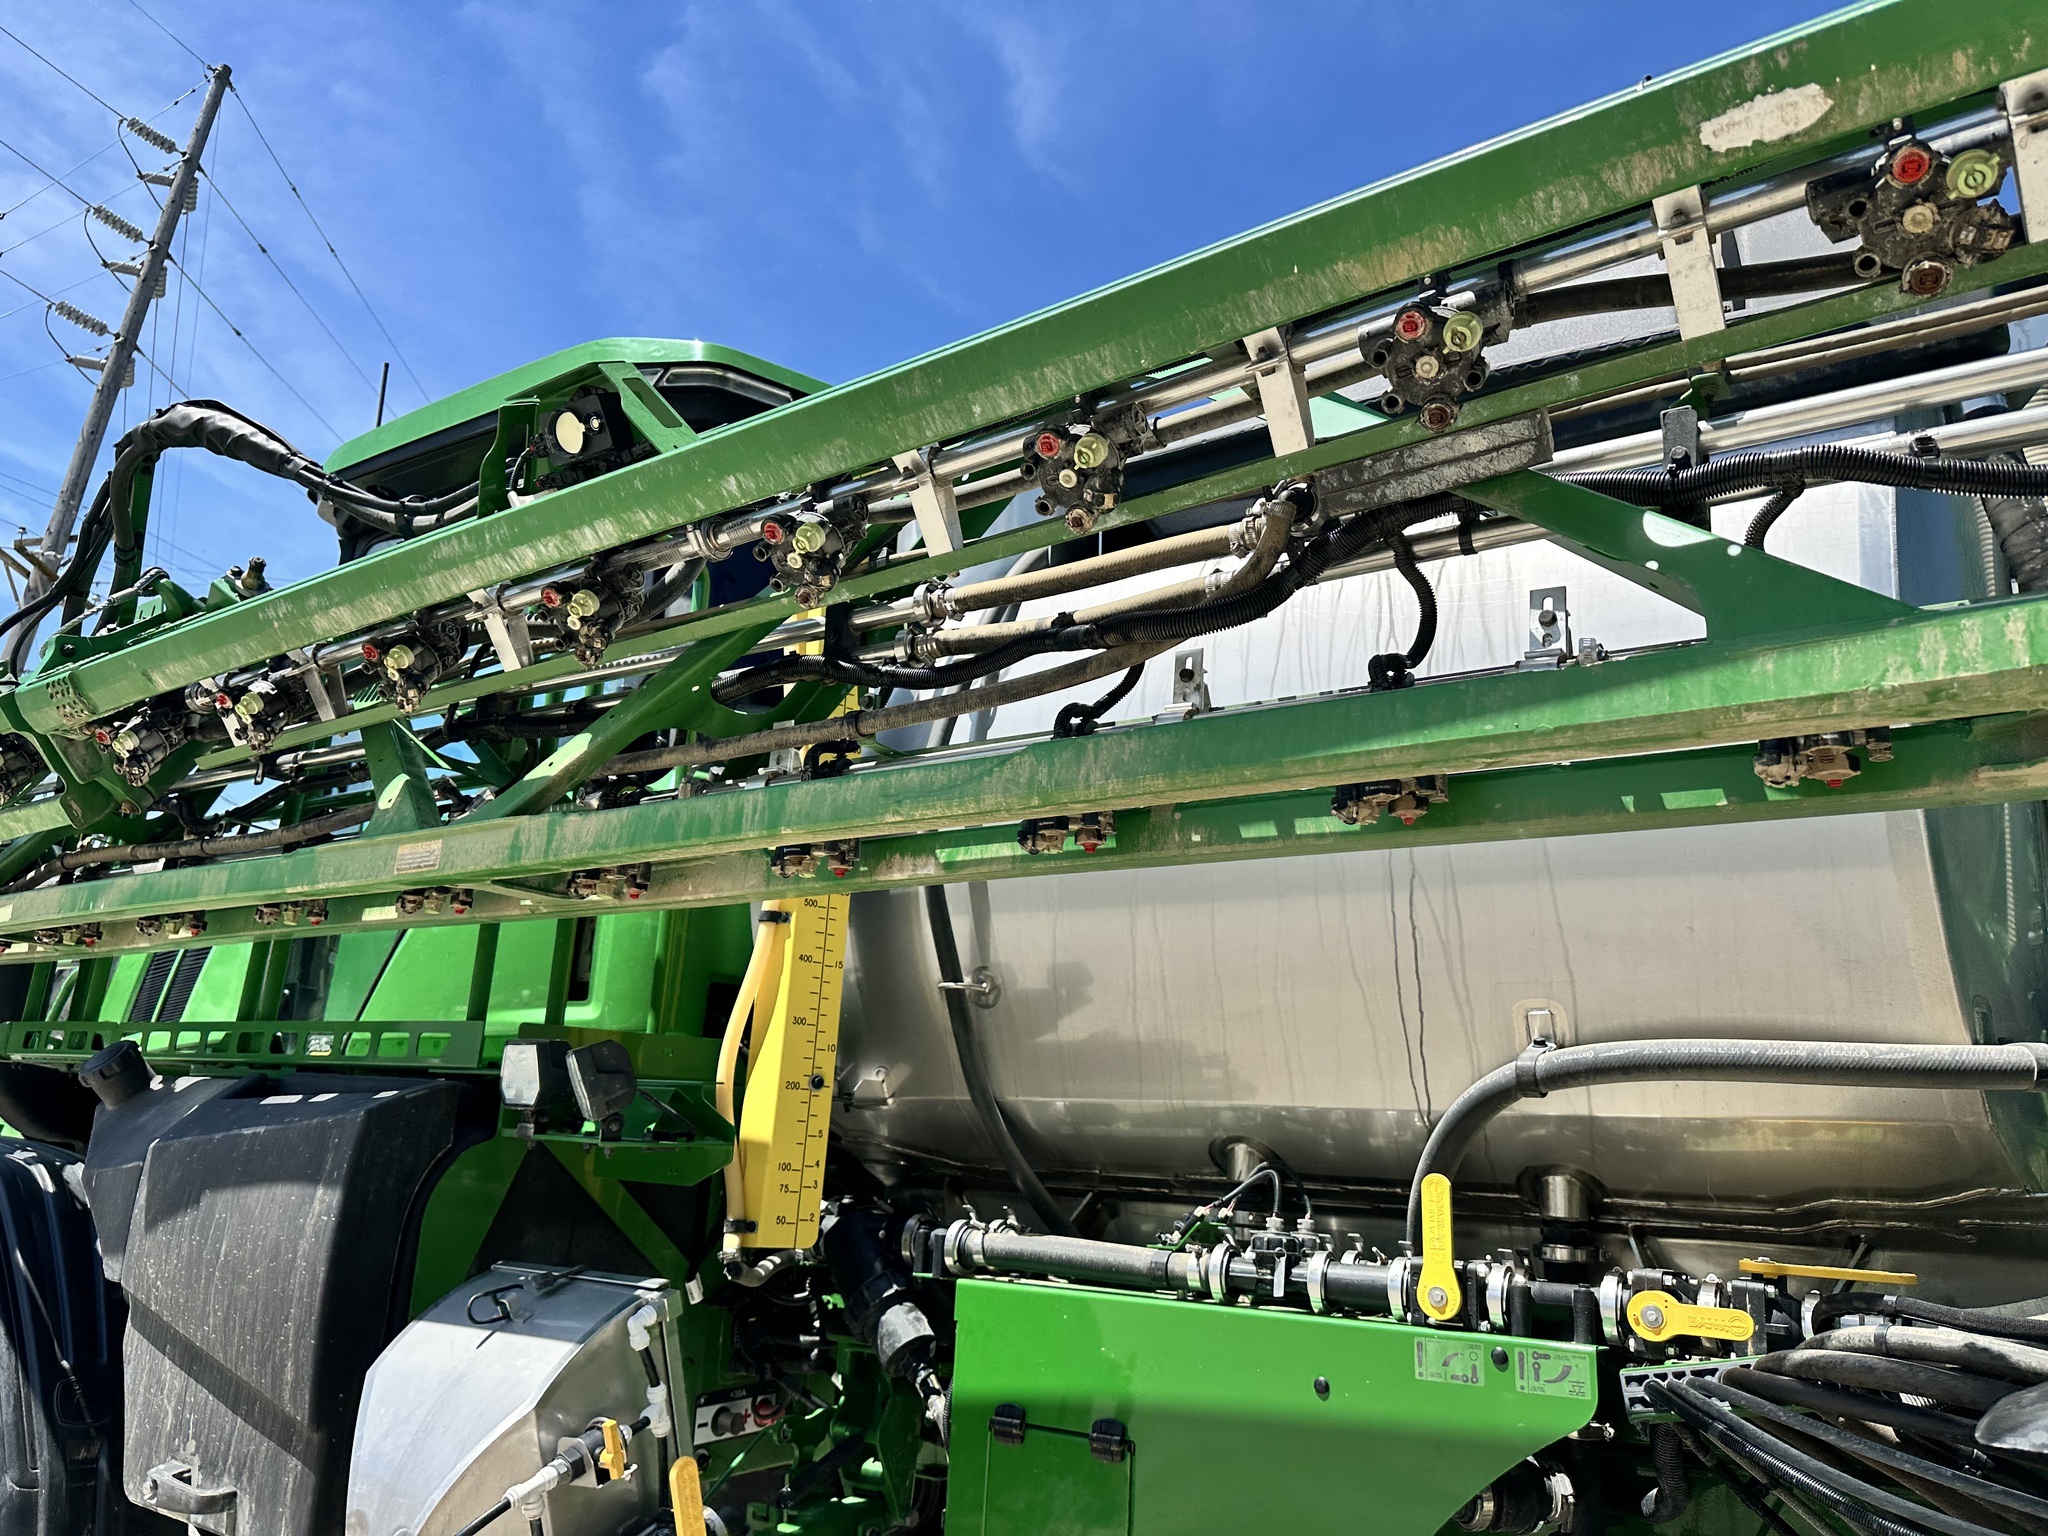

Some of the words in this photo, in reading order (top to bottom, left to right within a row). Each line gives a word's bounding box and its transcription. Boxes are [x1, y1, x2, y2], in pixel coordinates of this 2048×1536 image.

[804, 899, 818, 908] 500
[798, 954, 813, 963] 400
[834, 961, 844, 969] 15
[792, 1016, 807, 1026] 300
[827, 1044, 836, 1053] 10
[785, 1081, 800, 1090] 200
[817, 1130, 823, 1139] 5
[777, 1162, 792, 1171] 100
[814, 1160, 820, 1169] 4
[779, 1184, 790, 1193] 75
[812, 1180, 818, 1189] 3
[775, 1216, 787, 1225] 50
[809, 1213, 815, 1222] 2
